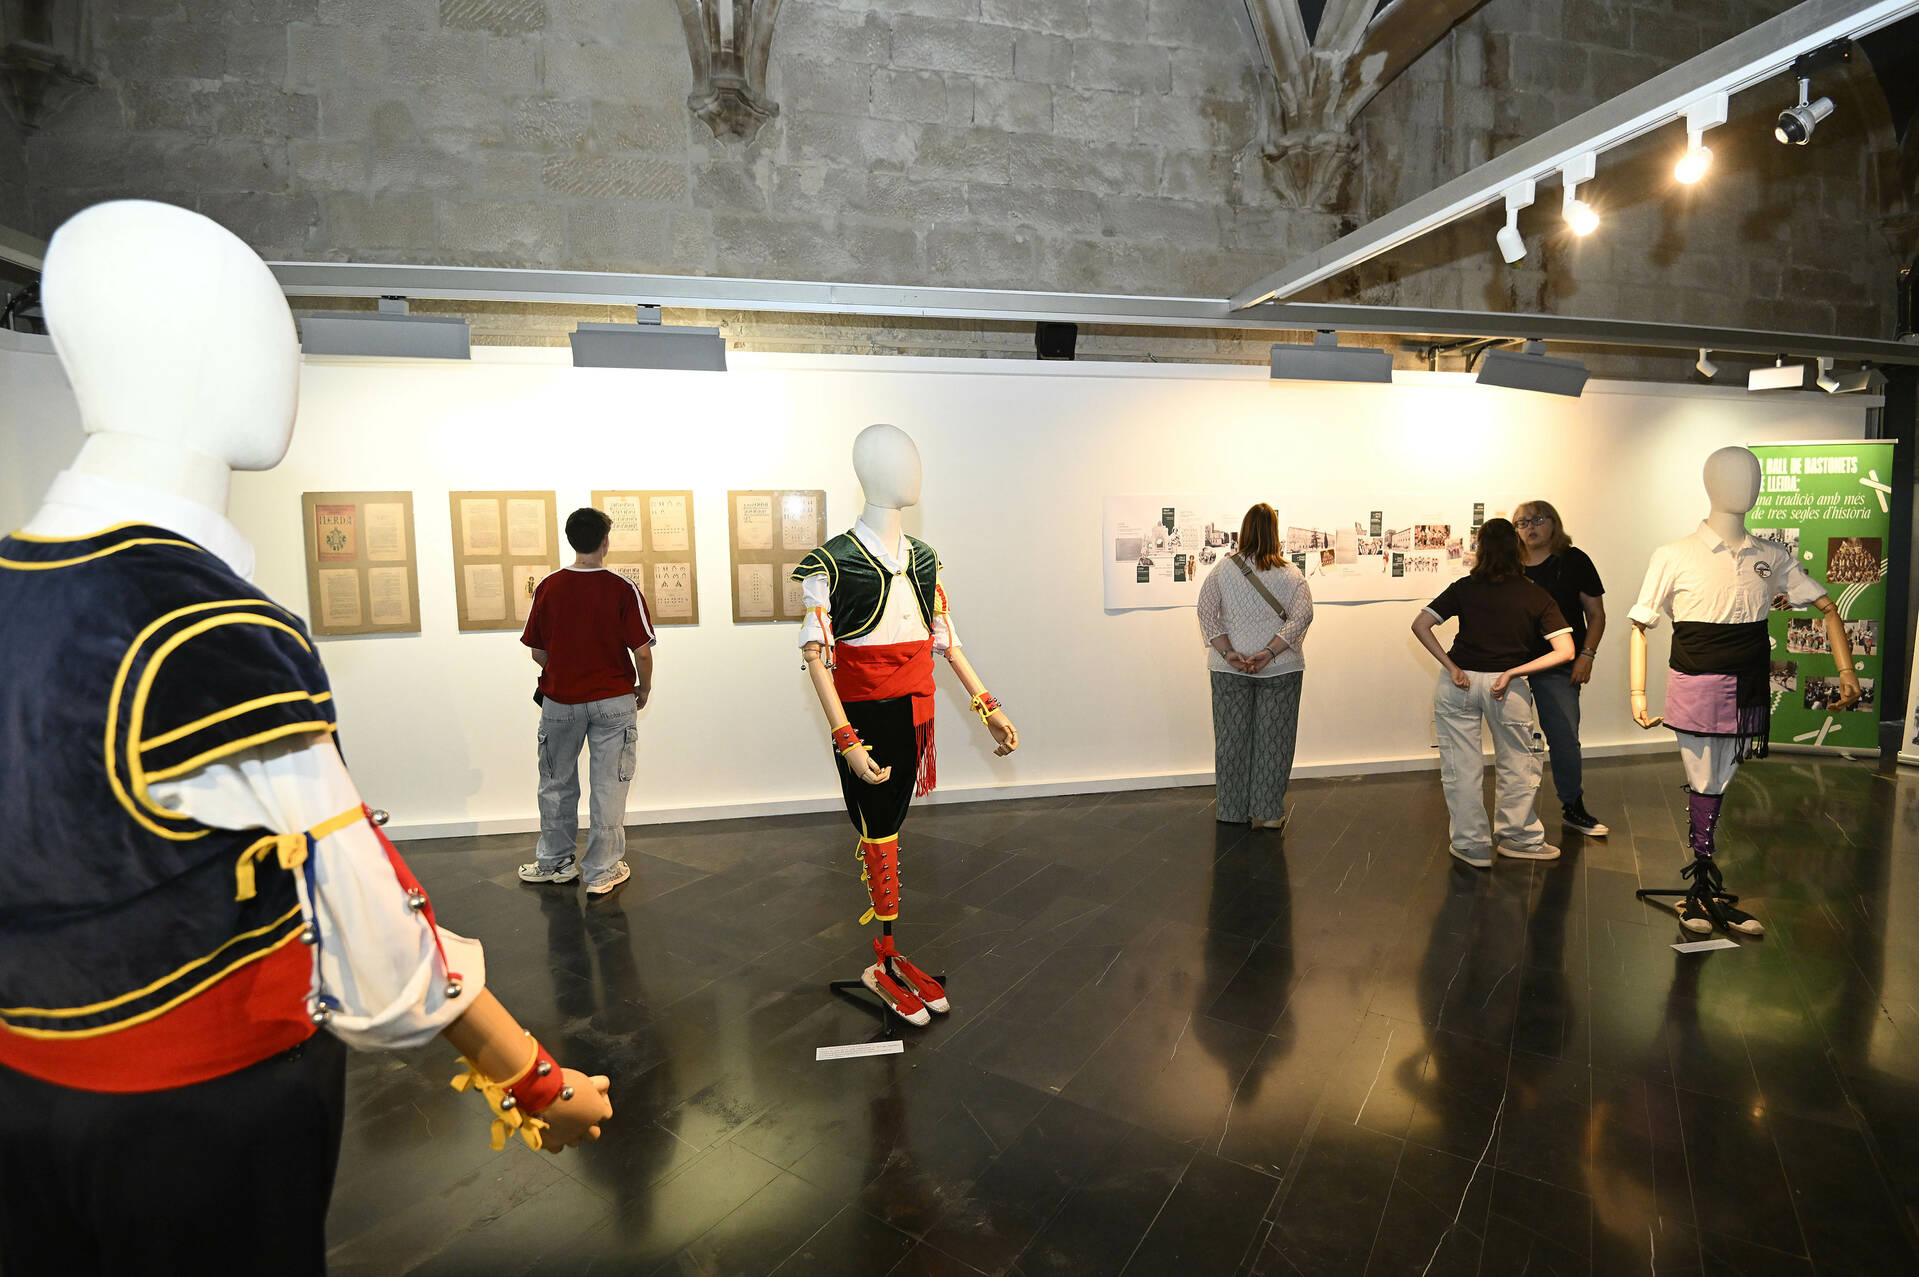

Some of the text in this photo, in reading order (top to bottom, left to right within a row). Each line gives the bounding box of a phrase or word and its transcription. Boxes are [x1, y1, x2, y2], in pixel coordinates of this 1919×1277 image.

[1766, 458, 1788, 475] BALL
[1790, 457, 1802, 474] DE
[1804, 456, 1858, 474] BASTONETS
[1767, 475, 1800, 492] LLEIDA:
[1775, 492, 1814, 506] tradició
[1816, 492, 1840, 506] amb
[1843, 493, 1865, 505] més
[1751, 506, 1871, 523] de tres segles d'història
